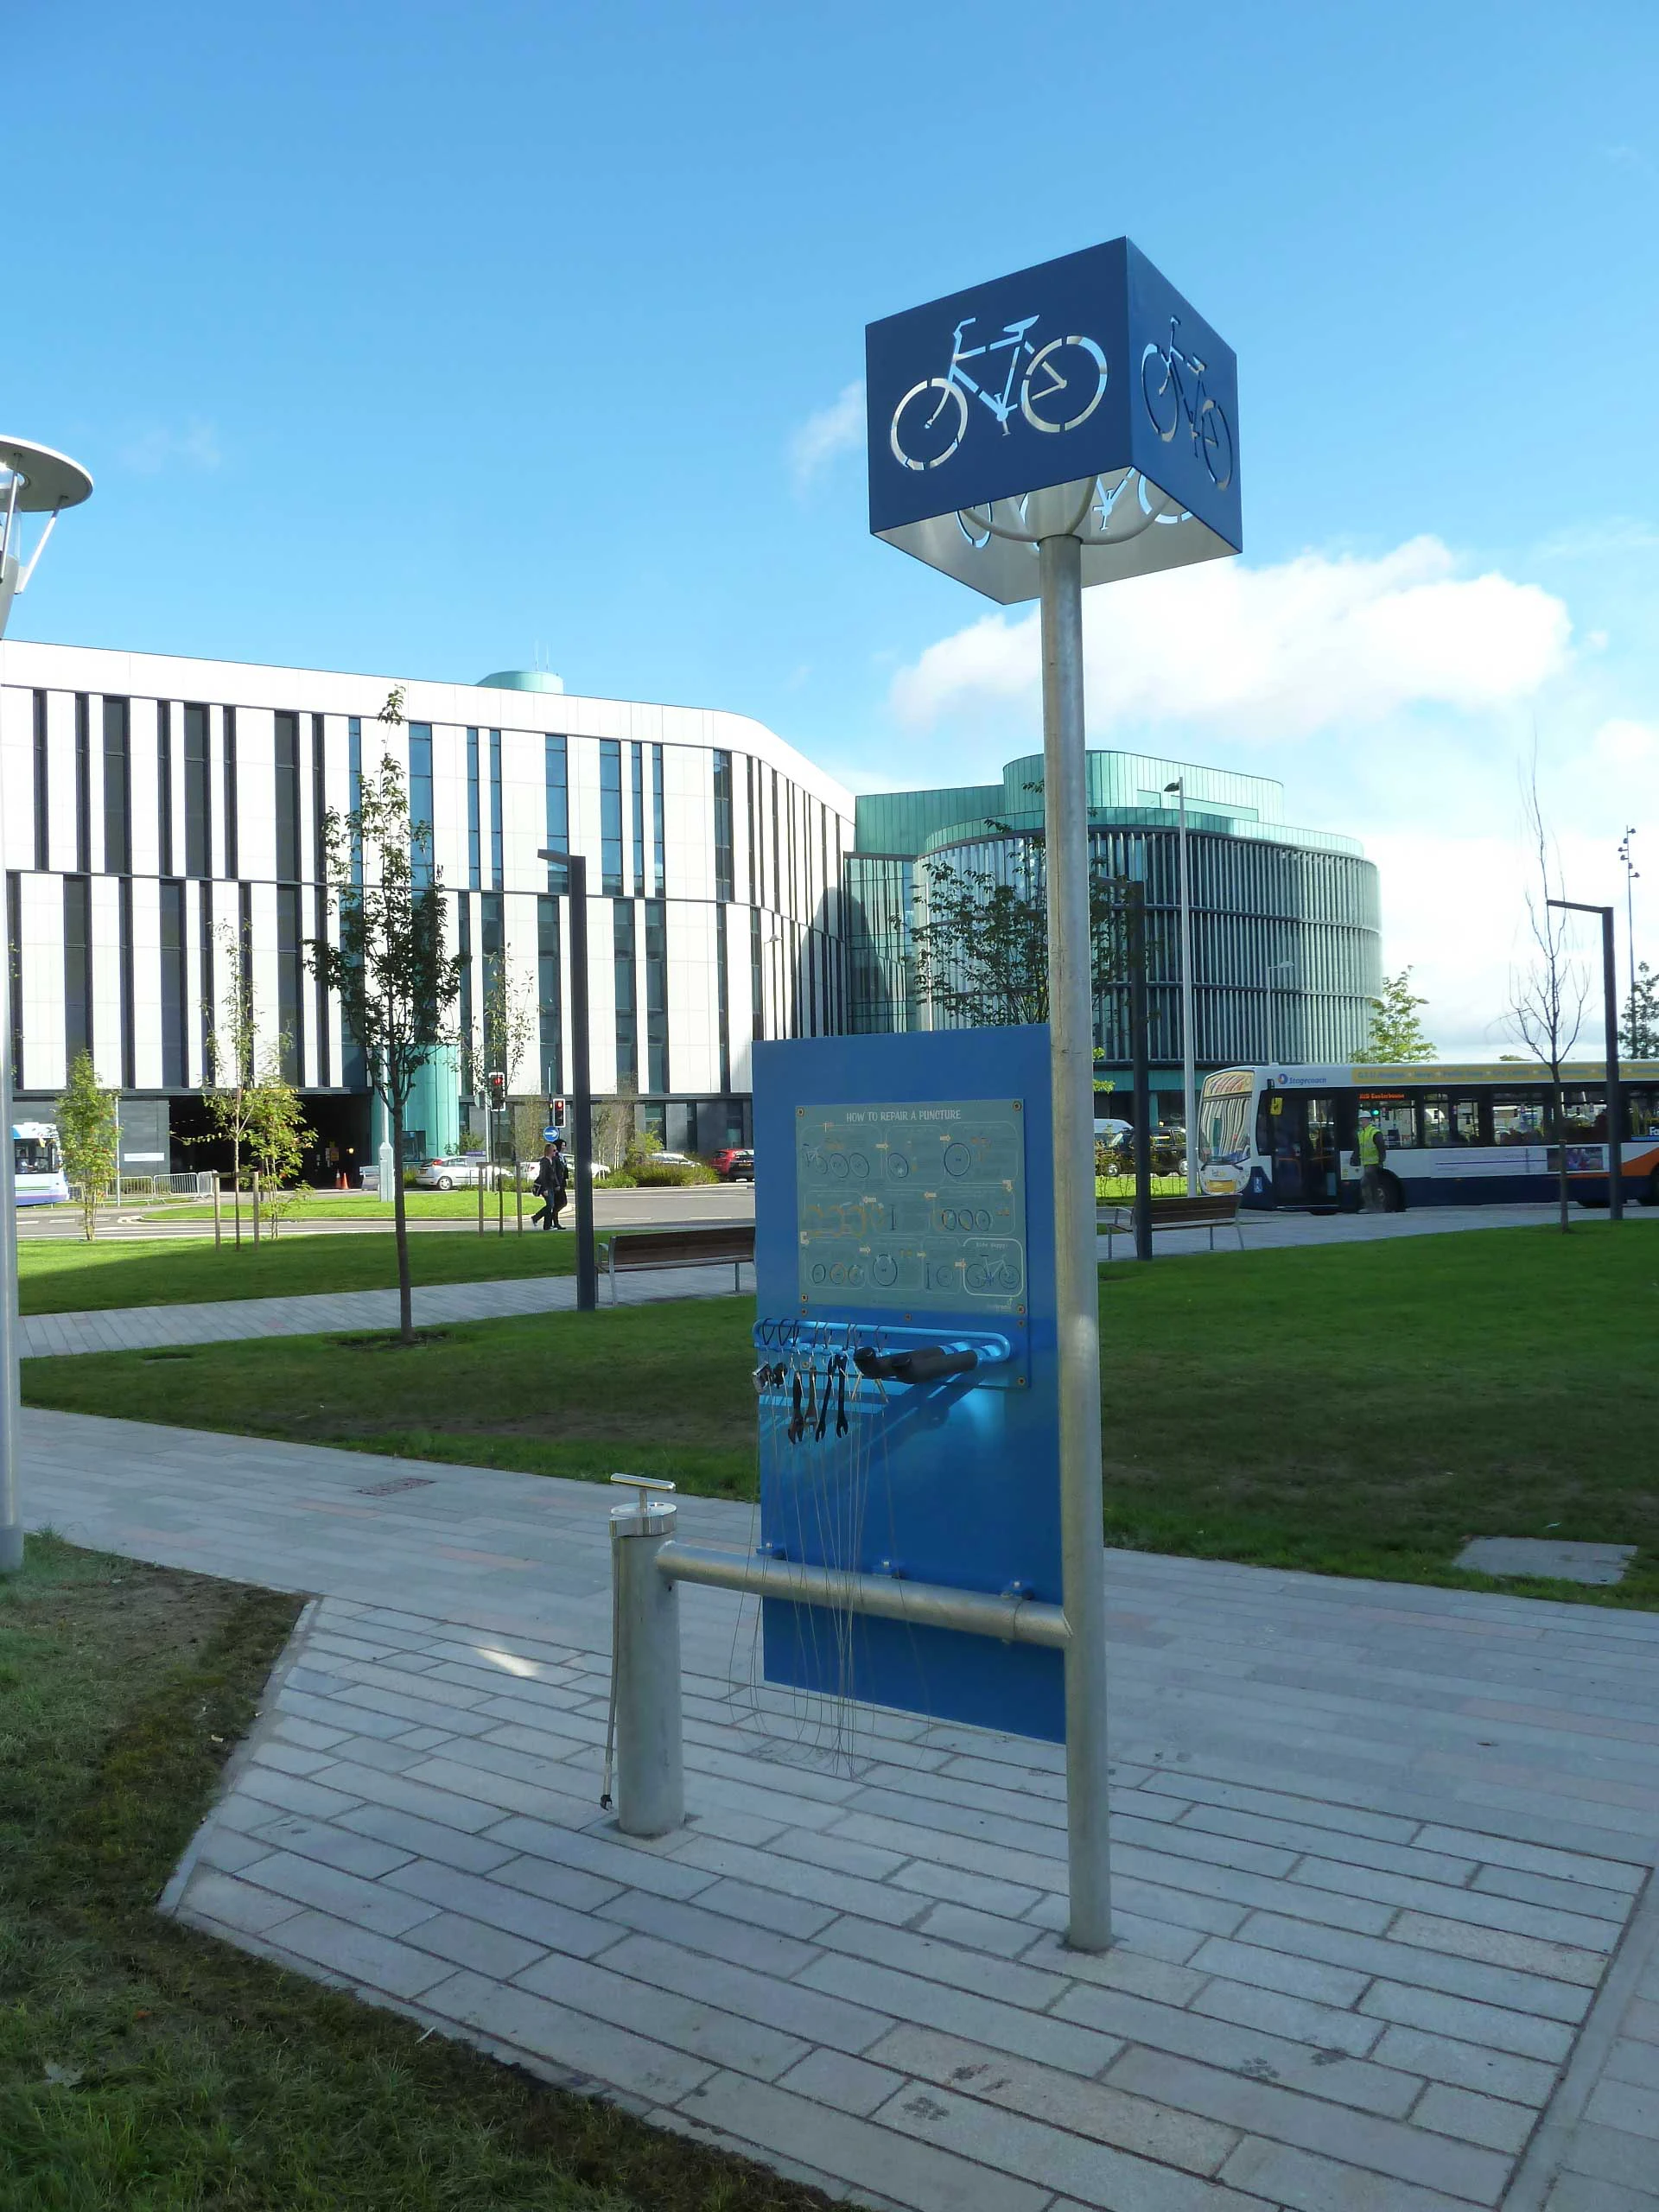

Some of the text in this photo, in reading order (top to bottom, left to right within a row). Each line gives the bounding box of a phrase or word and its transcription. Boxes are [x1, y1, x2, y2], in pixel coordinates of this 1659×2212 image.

[1288, 1077, 1327, 1086] Stagecoach
[846, 1109, 962, 1122] HOW TO REPAIR A PUNCTURE
